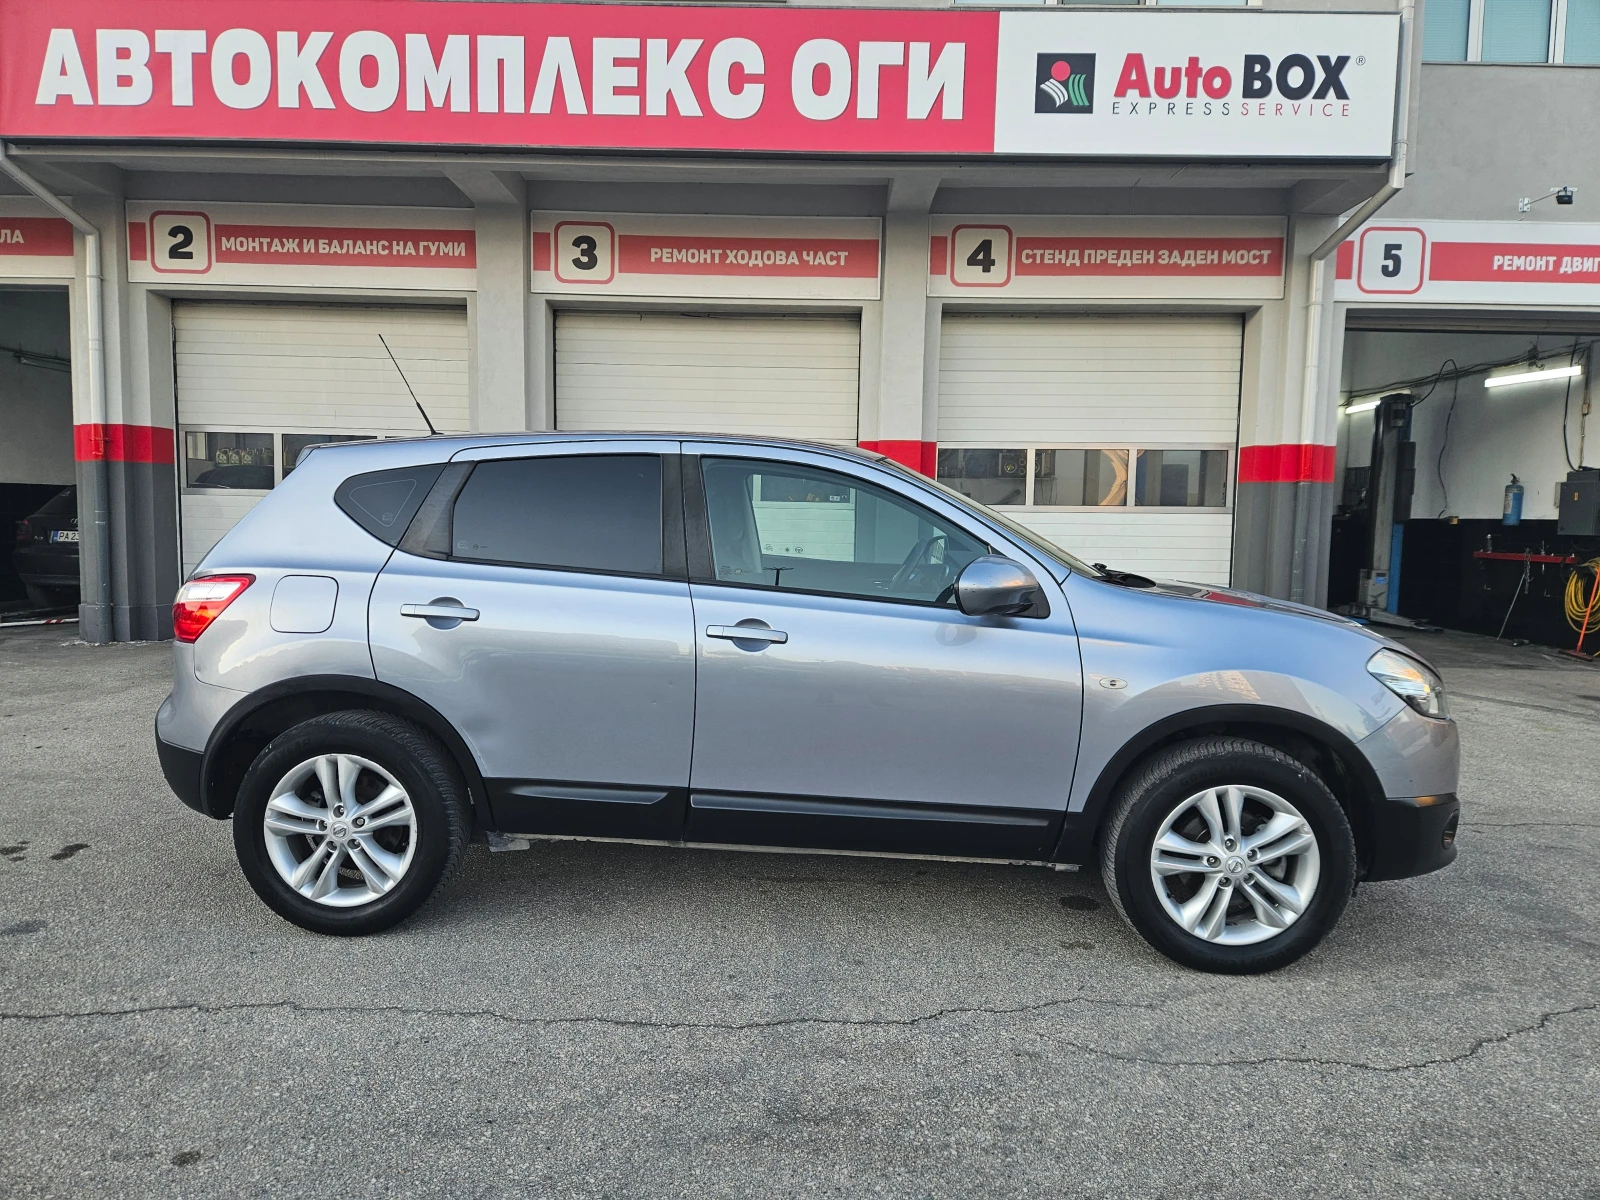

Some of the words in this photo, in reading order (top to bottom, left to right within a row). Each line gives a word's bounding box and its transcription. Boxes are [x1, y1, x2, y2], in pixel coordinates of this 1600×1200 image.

[35, 27, 765, 120] АВТОКОМПЛЕКС
[791, 38, 966, 121] ОГИ
[1113, 53, 1232, 100] Auto
[1241, 53, 1351, 101] BOX
[1112, 101, 1230, 116] EXPRESS
[1240, 102, 1350, 117] SERVICE
[167, 225, 194, 260] 2
[221, 237, 300, 253] МОНТАЖ
[303, 239, 315, 253] И
[318, 239, 389, 255] БАЛАНС
[392, 241, 417, 255] НА
[419, 242, 466, 256] ГУМИ
[571, 235, 598, 271] 3
[650, 248, 723, 264] РЕМОНТ
[725, 250, 800, 267] ХОДОВА
[802, 251, 849, 266] ЧАСТ
[966, 238, 996, 273] 4
[1021, 249, 1081, 266] СТЕНД
[1083, 249, 1155, 267] ПРЕДЕН
[1157, 250, 1219, 267] ЗАДЕН
[1222, 249, 1271, 265] МОСТ
[1381, 243, 1403, 278] 5
[1493, 255, 1557, 271] РЕМОНТ
